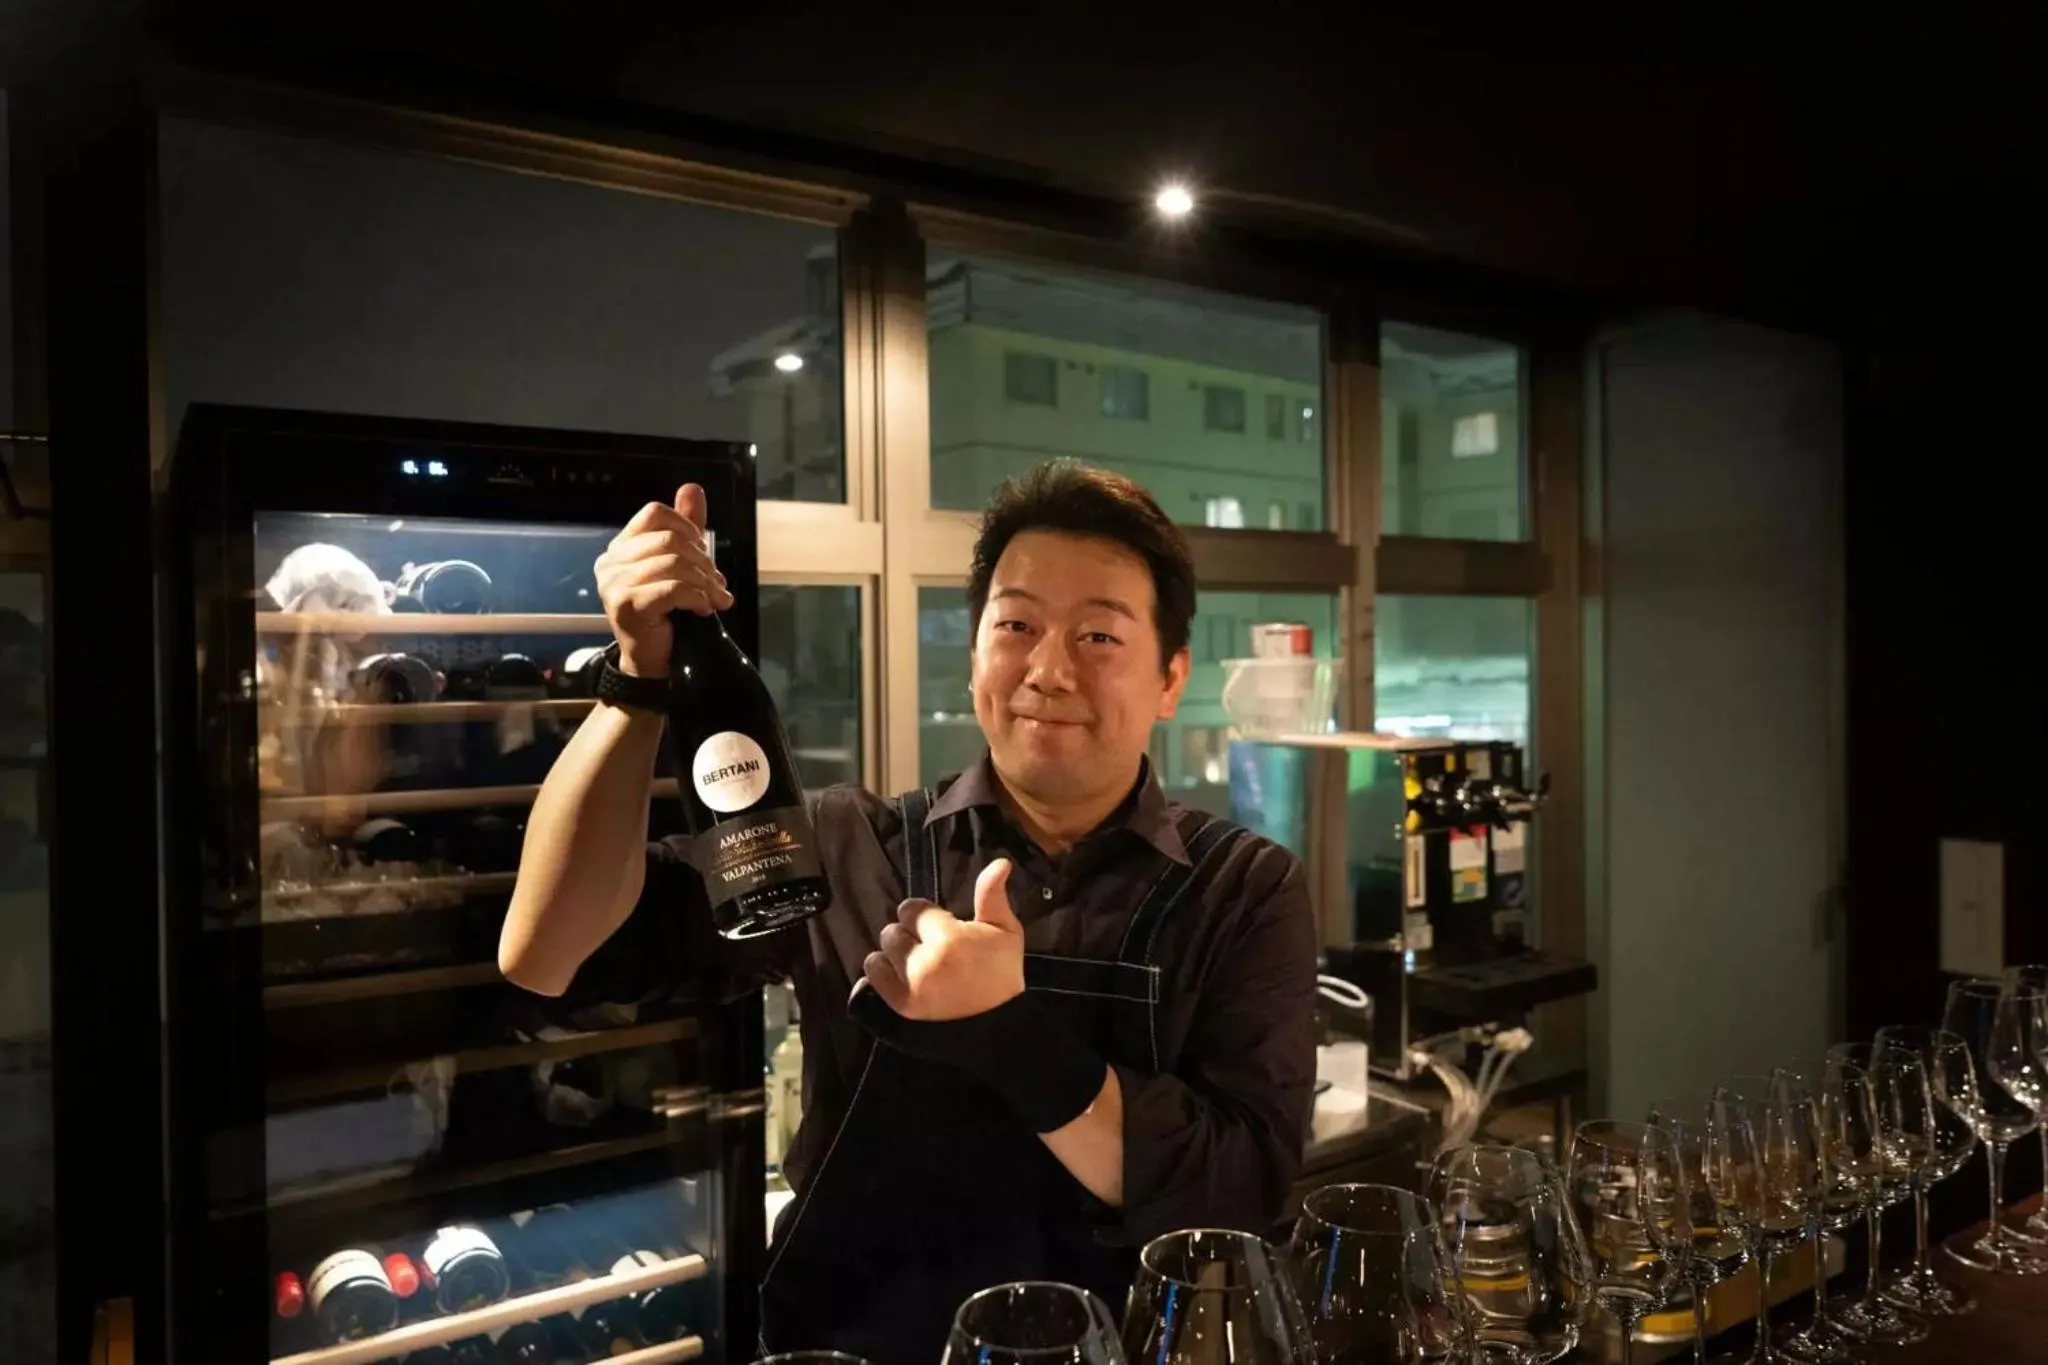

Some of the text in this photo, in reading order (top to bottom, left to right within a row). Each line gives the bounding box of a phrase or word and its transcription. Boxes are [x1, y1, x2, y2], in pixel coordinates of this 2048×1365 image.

[703, 759, 760, 786] BERTANI
[720, 822, 778, 849] AMARONE
[722, 853, 793, 882] VALPANTENA
